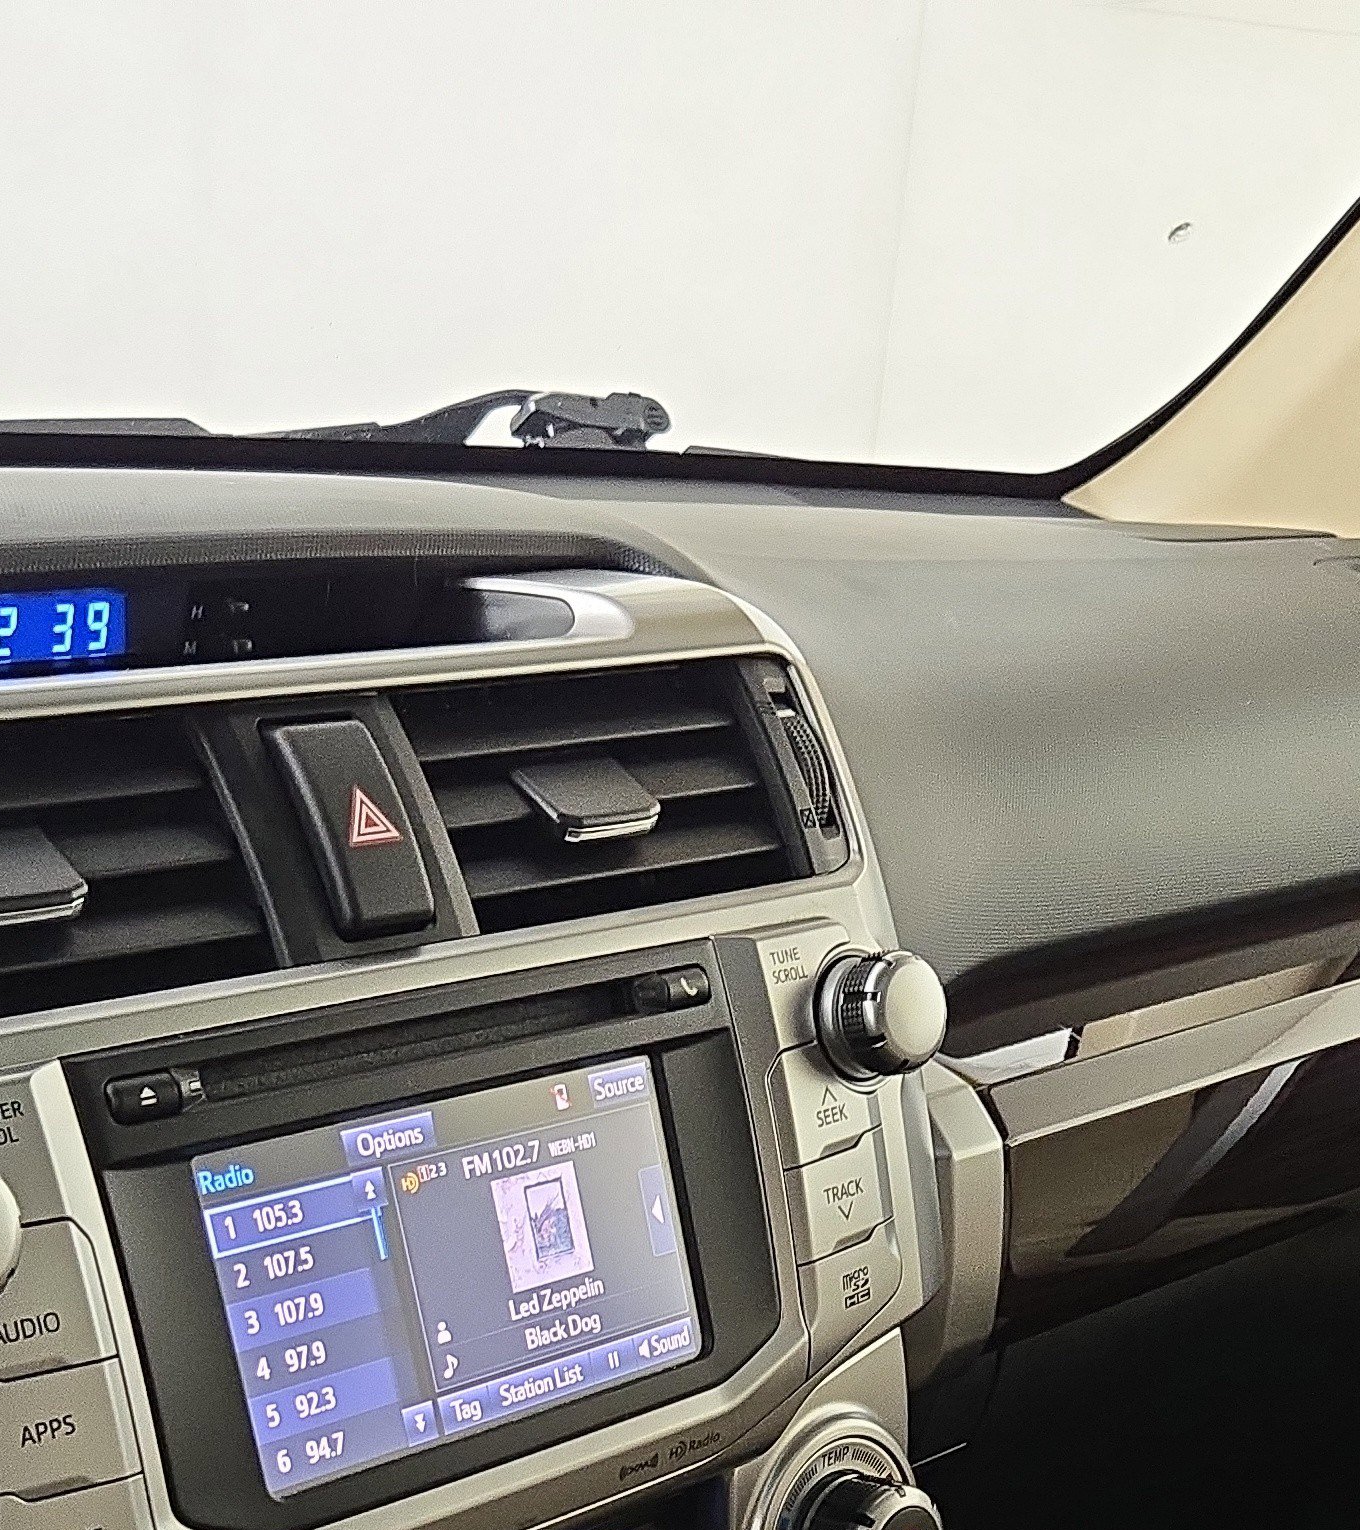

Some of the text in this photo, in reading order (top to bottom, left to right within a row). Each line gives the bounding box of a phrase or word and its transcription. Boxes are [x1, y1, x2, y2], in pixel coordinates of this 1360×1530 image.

[51, 601, 111, 654] 39
[769, 947, 801, 965] TUNE
[772, 962, 809, 984] SCROLL
[593, 1073, 645, 1101] Source
[816, 1103, 848, 1128] SEEK
[356, 1126, 424, 1158] Options
[462, 1151, 493, 1180] FM
[494, 1140, 541, 1172] 102.7
[197, 1164, 256, 1196] Radio
[823, 1177, 864, 1205] TRACK
[224, 1200, 304, 1241] 1 105.3
[233, 1246, 315, 1289] 2 107.5
[244, 1292, 325, 1335] 3 107.9
[508, 1278, 605, 1321] Led Zeppelin
[524, 1313, 602, 1350] Black Dog
[651, 1326, 691, 1357] Sound
[256, 1341, 327, 1381] 4 97.9
[499, 1363, 585, 1407] Station List
[266, 1386, 337, 1428] 5 92.3
[449, 1398, 483, 1422] Tag
[20, 1415, 77, 1448] APPS
[276, 1431, 345, 1473] 6 94.7
[820, 1445, 850, 1470] TEMP
